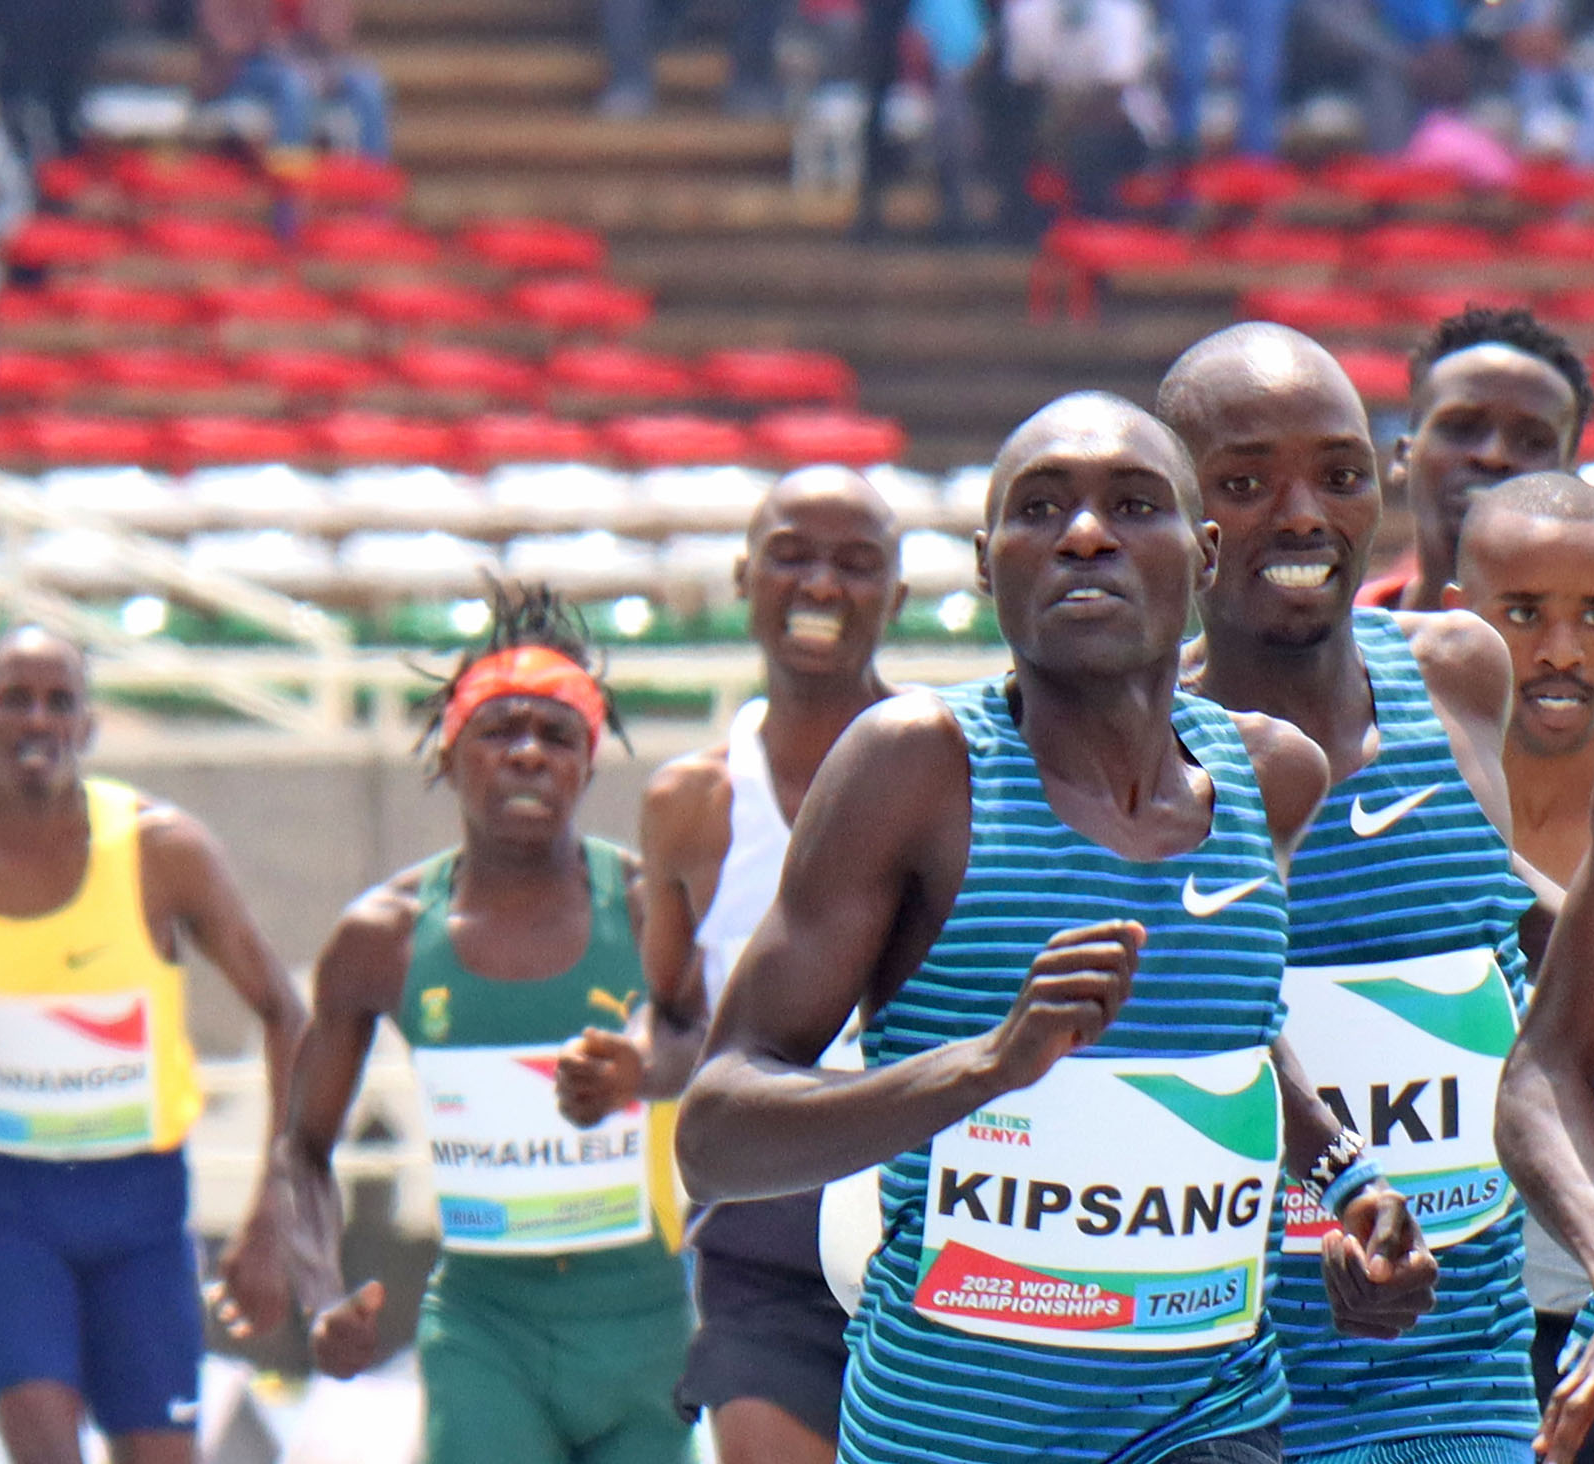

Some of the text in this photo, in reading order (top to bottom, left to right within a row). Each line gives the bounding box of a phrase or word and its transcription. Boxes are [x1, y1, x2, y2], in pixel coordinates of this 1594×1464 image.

[968, 1124, 1032, 1148] KENYA
[937, 1167, 1263, 1238] KIPSANG
[960, 1275, 1102, 1301] 2022 WORLD
[1147, 1276, 1239, 1320] TRIALS
[931, 1289, 1121, 1317] CHAMPIONSHIPS
